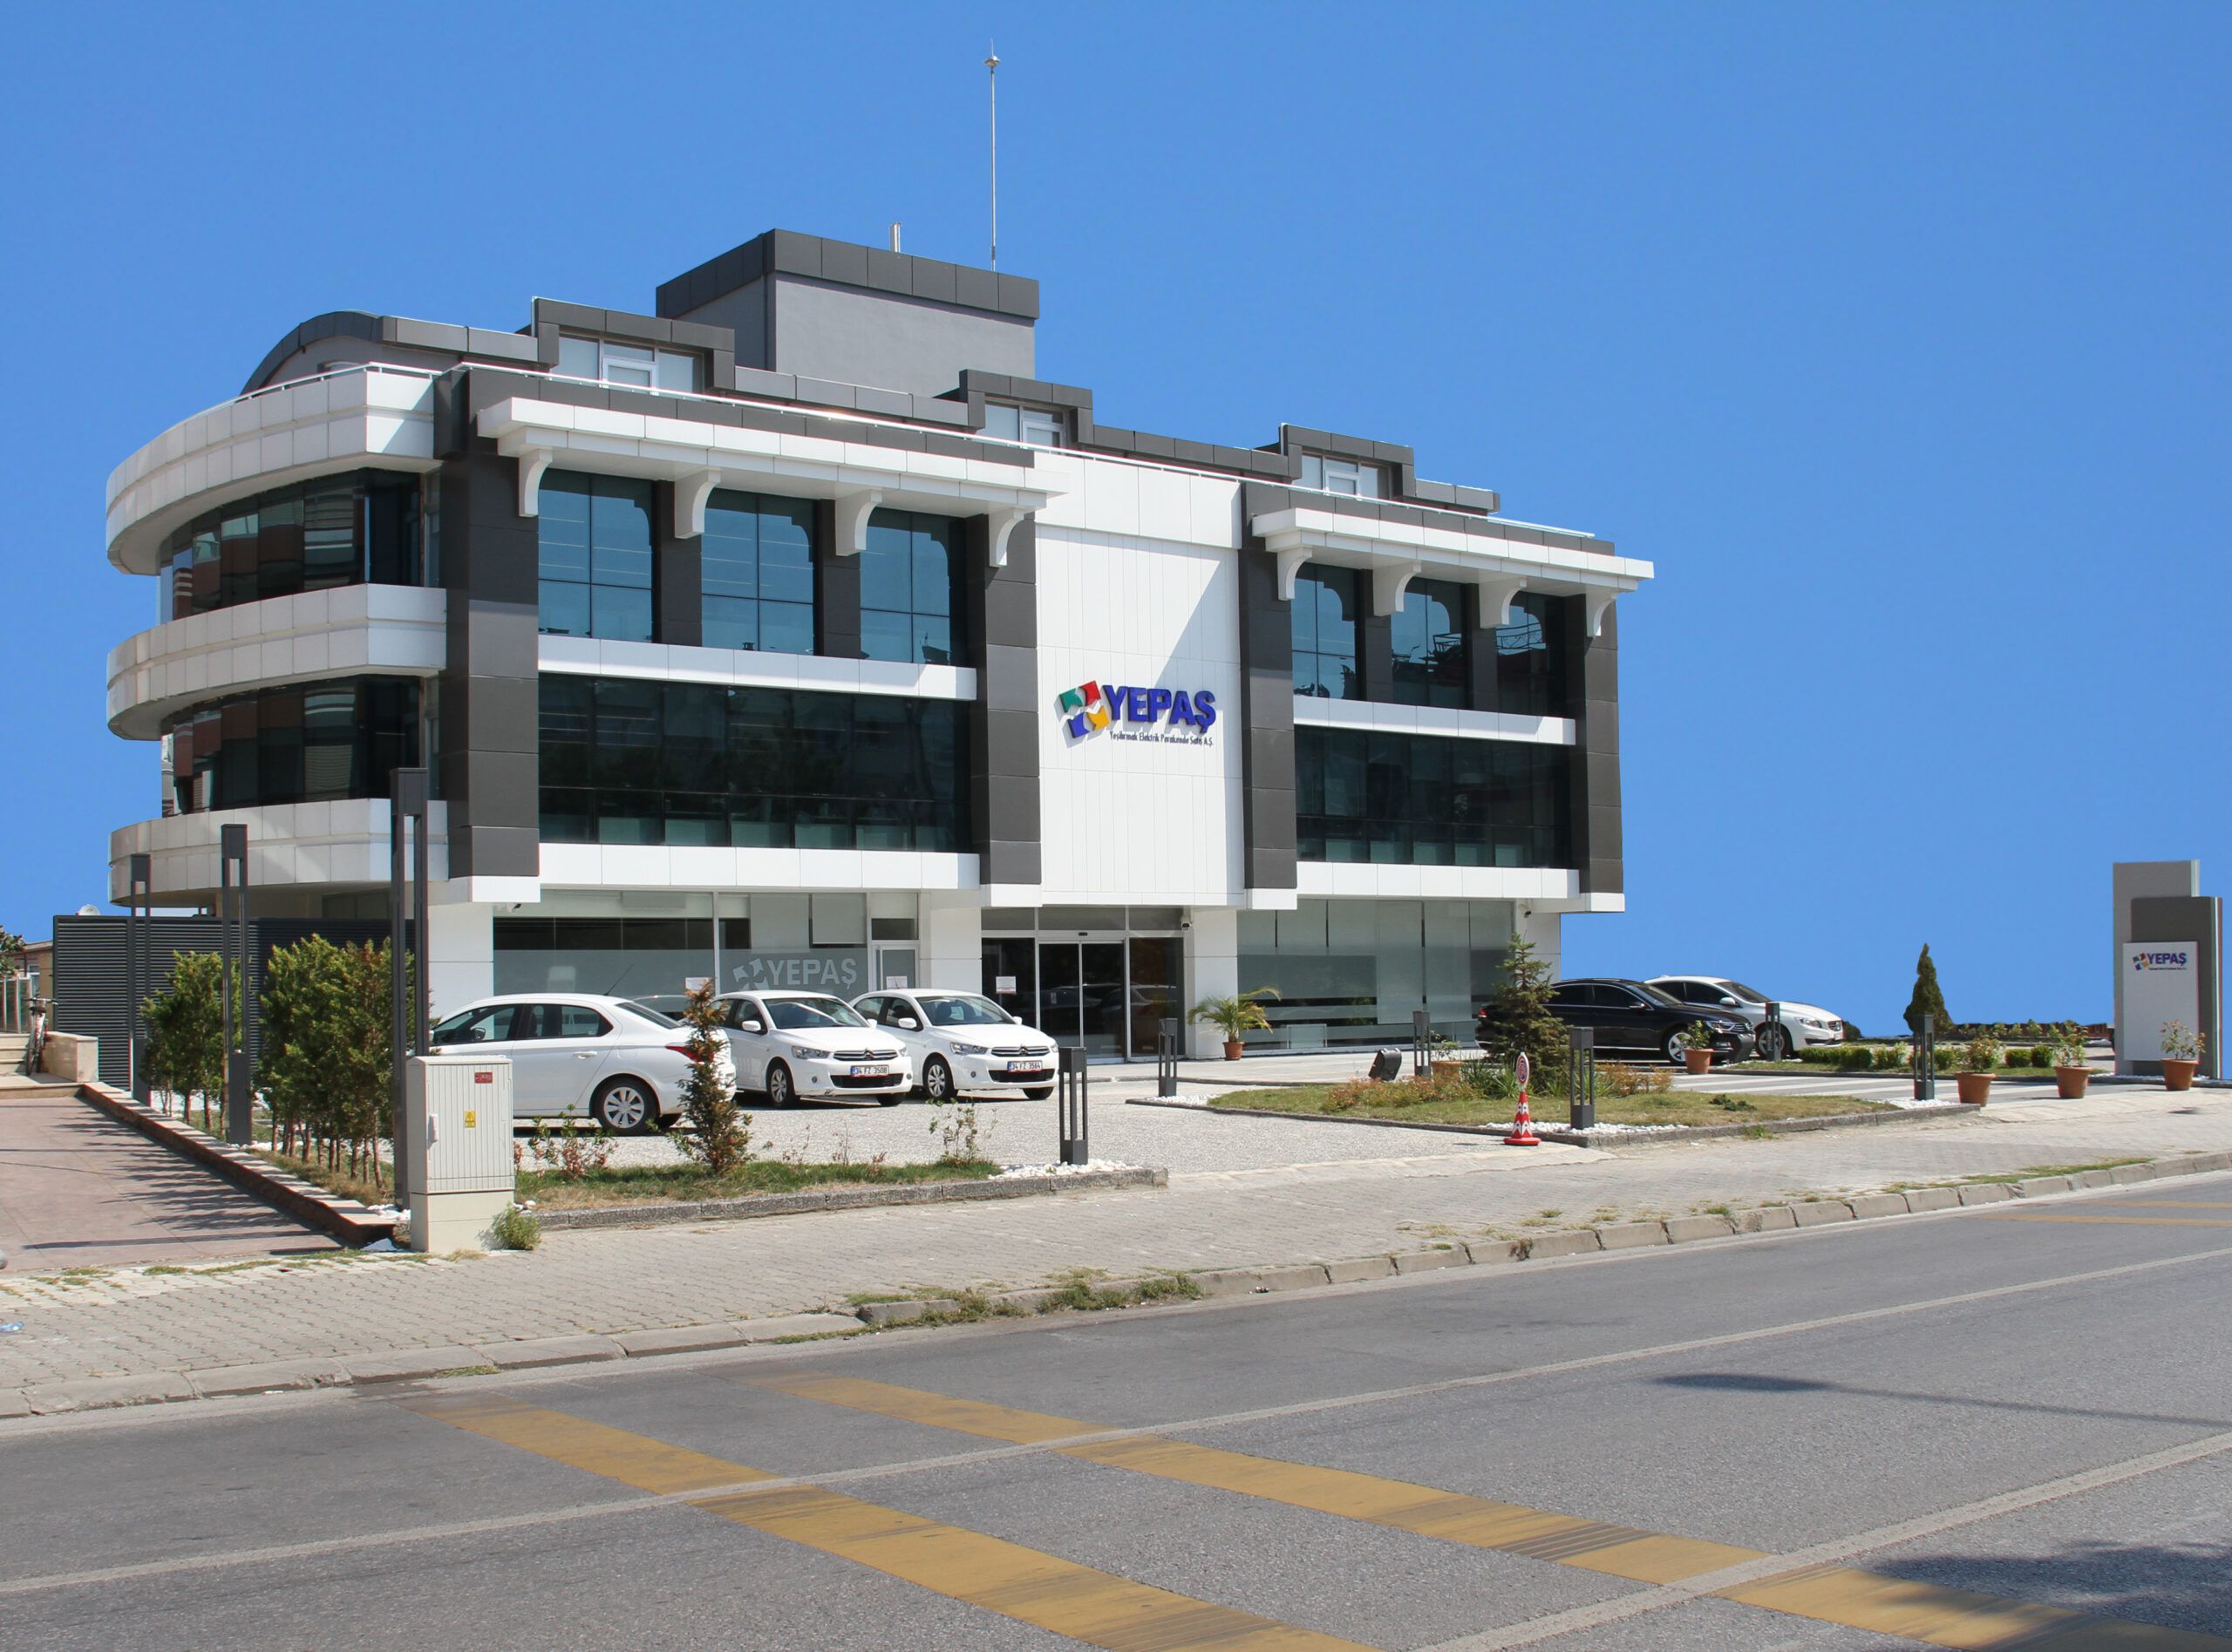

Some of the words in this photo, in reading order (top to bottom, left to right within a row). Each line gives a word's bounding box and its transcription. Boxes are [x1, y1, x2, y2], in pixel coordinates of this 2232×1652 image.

[1102, 684, 1216, 734] YEPAŞ
[1139, 732, 1160, 742] Elektrik
[1160, 734, 1189, 744] Perakende
[2147, 952, 2187, 966] YEPAŞ
[766, 958, 857, 989] YEPAŞ
